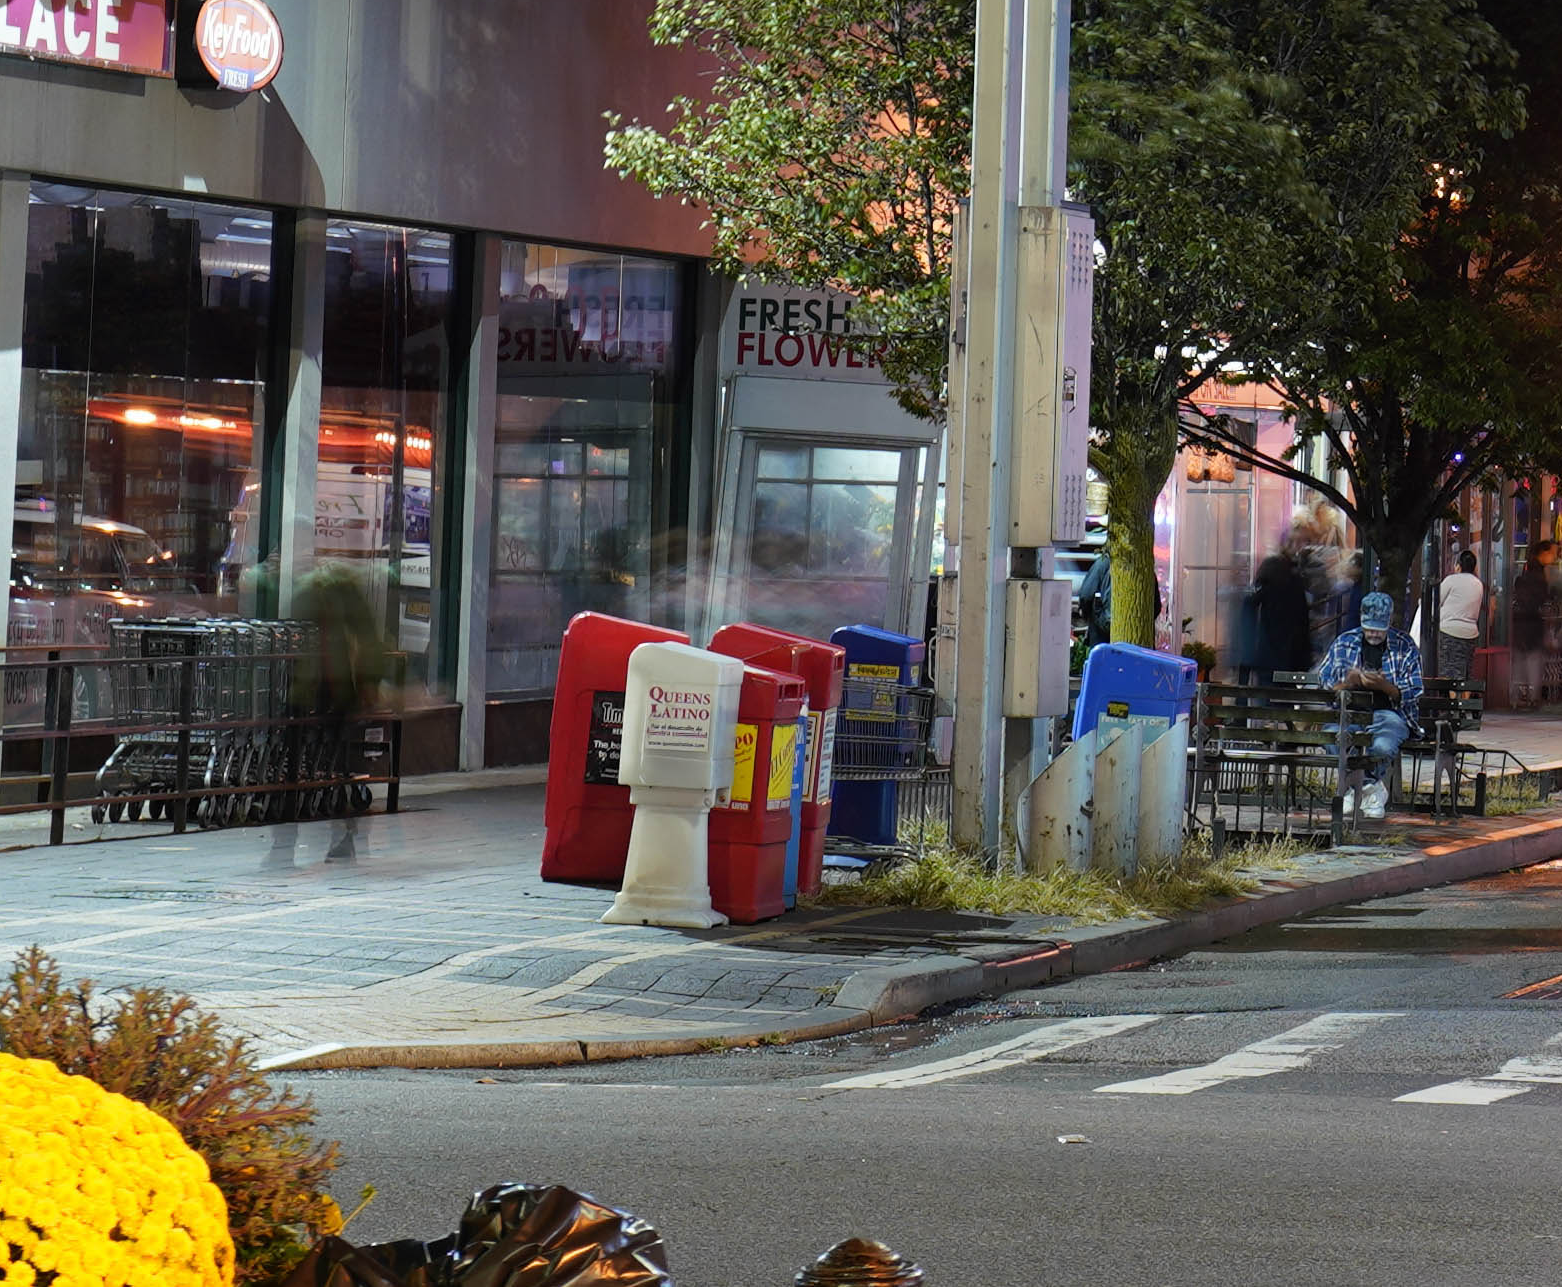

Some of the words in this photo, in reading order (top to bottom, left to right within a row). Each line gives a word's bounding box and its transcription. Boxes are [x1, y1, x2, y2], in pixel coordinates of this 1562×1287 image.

[224, 69, 249, 90] FRESH
[739, 298, 852, 334] FRESH
[649, 686, 711, 705] QUEENS
[649, 704, 710, 721] LATINO
